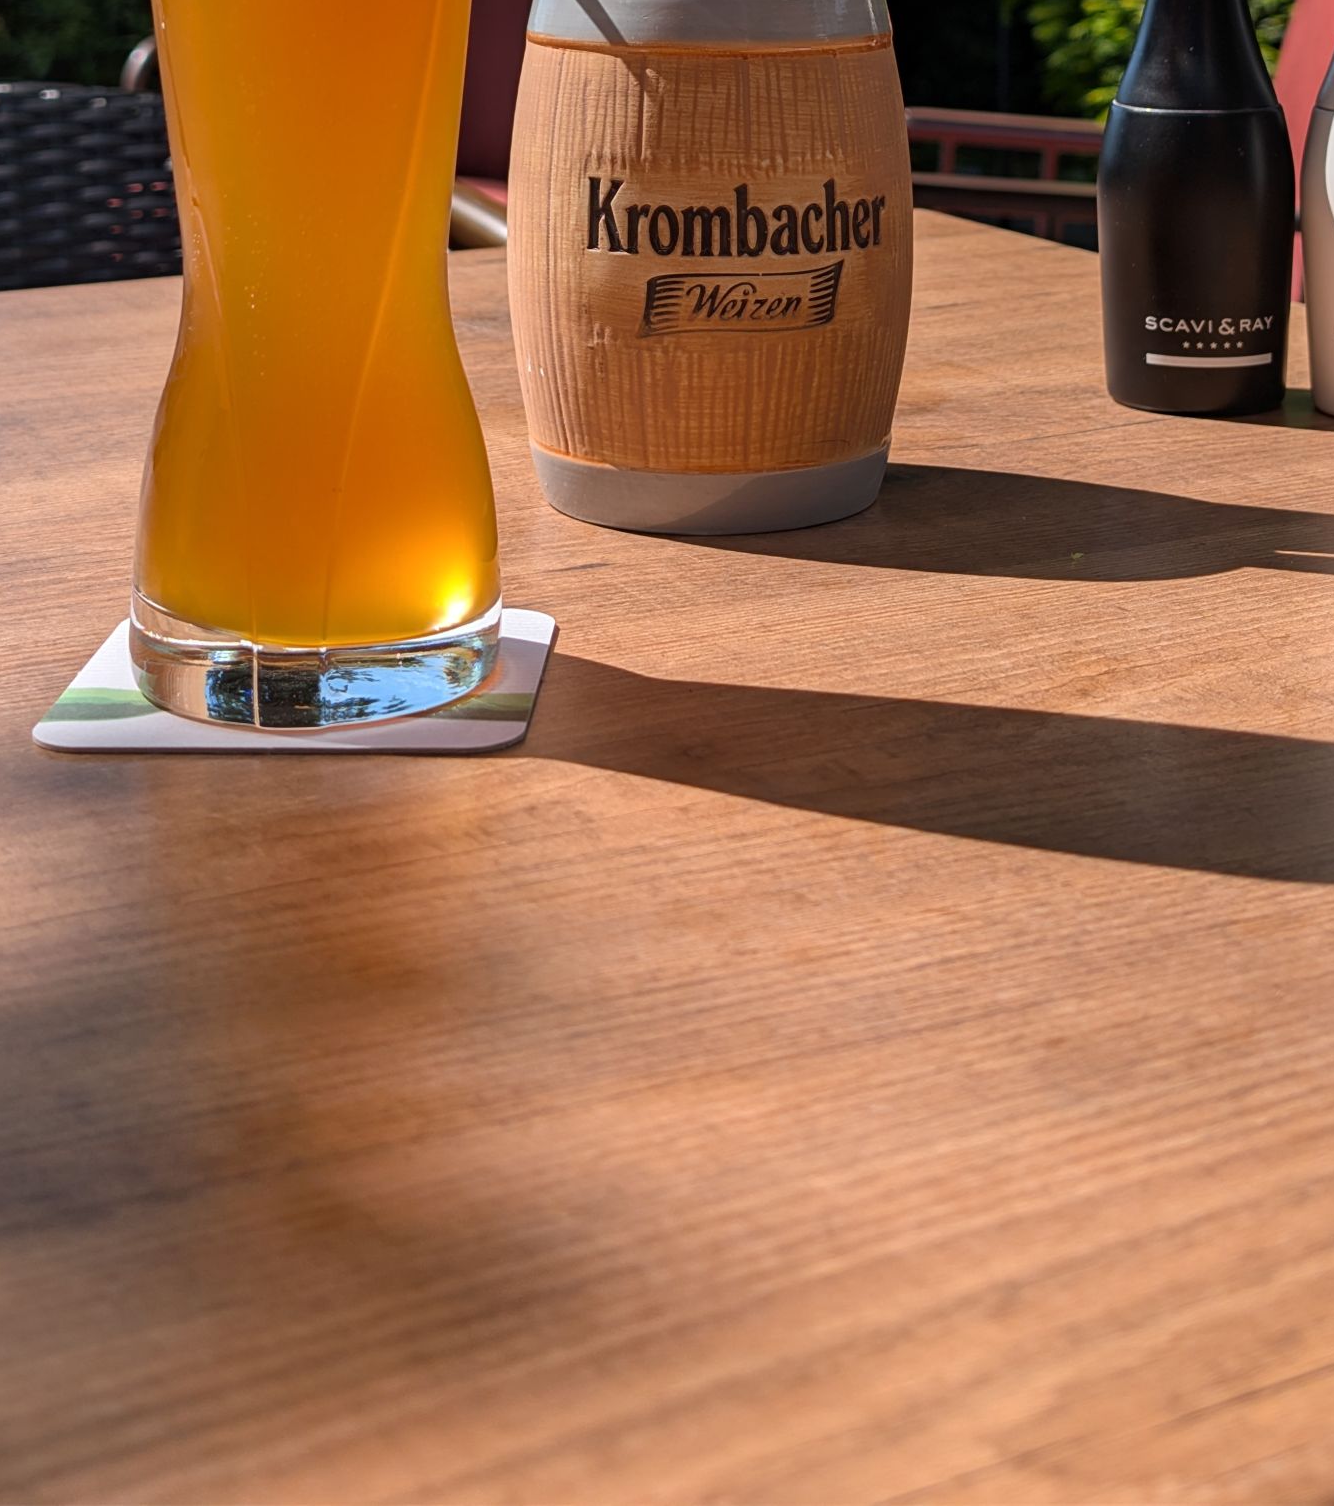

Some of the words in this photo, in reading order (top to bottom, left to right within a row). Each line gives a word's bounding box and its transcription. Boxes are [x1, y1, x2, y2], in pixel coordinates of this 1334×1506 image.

[587, 177, 886, 257] Krombacher
[685, 281, 803, 320] Weizen
[1145, 316, 1213, 334] SCAVI
[1239, 315, 1273, 332] RAY
